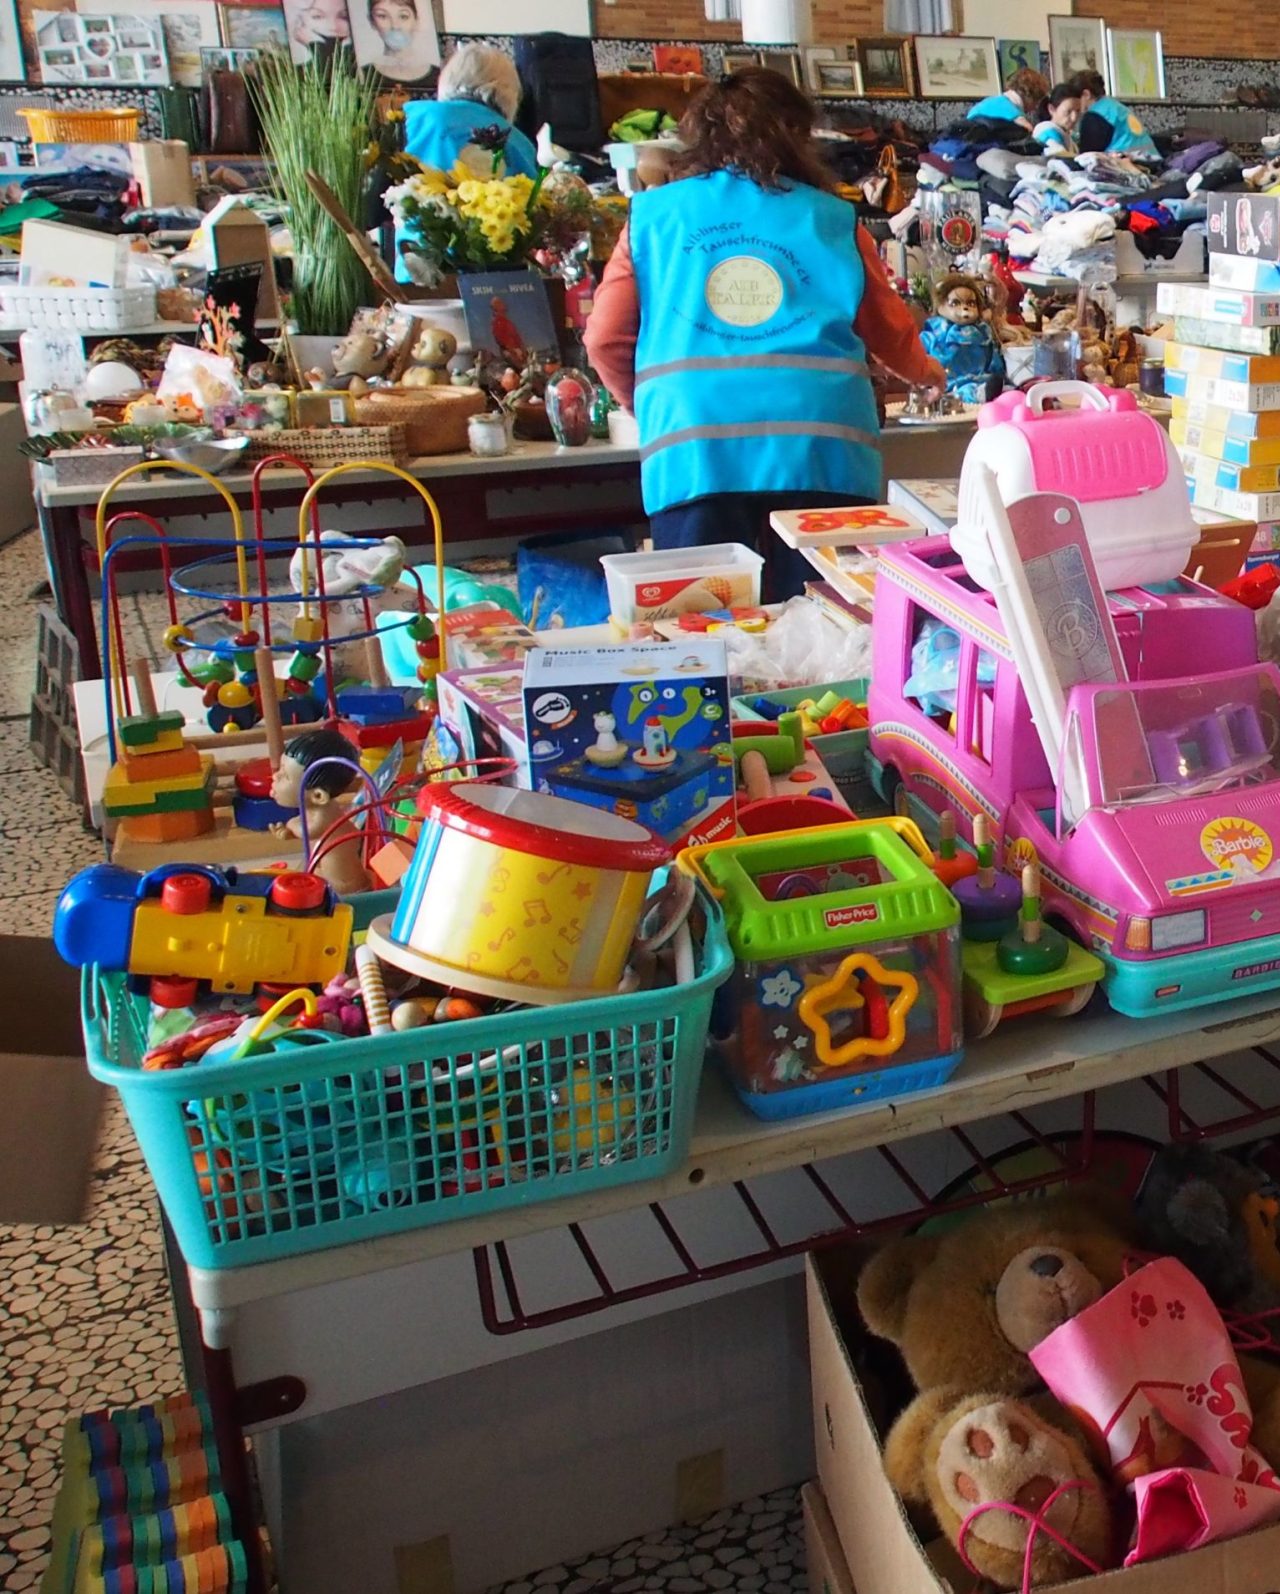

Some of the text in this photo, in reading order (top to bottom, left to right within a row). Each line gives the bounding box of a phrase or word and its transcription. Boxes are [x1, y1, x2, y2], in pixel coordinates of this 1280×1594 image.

[682, 221, 743, 256] Aiblinger
[630, 645, 679, 653] Space
[703, 686, 717, 697] 3+
[707, 815, 735, 840] music
[1213, 832, 1266, 853] Barbie
[826, 907, 877, 923] Fisher-Price
